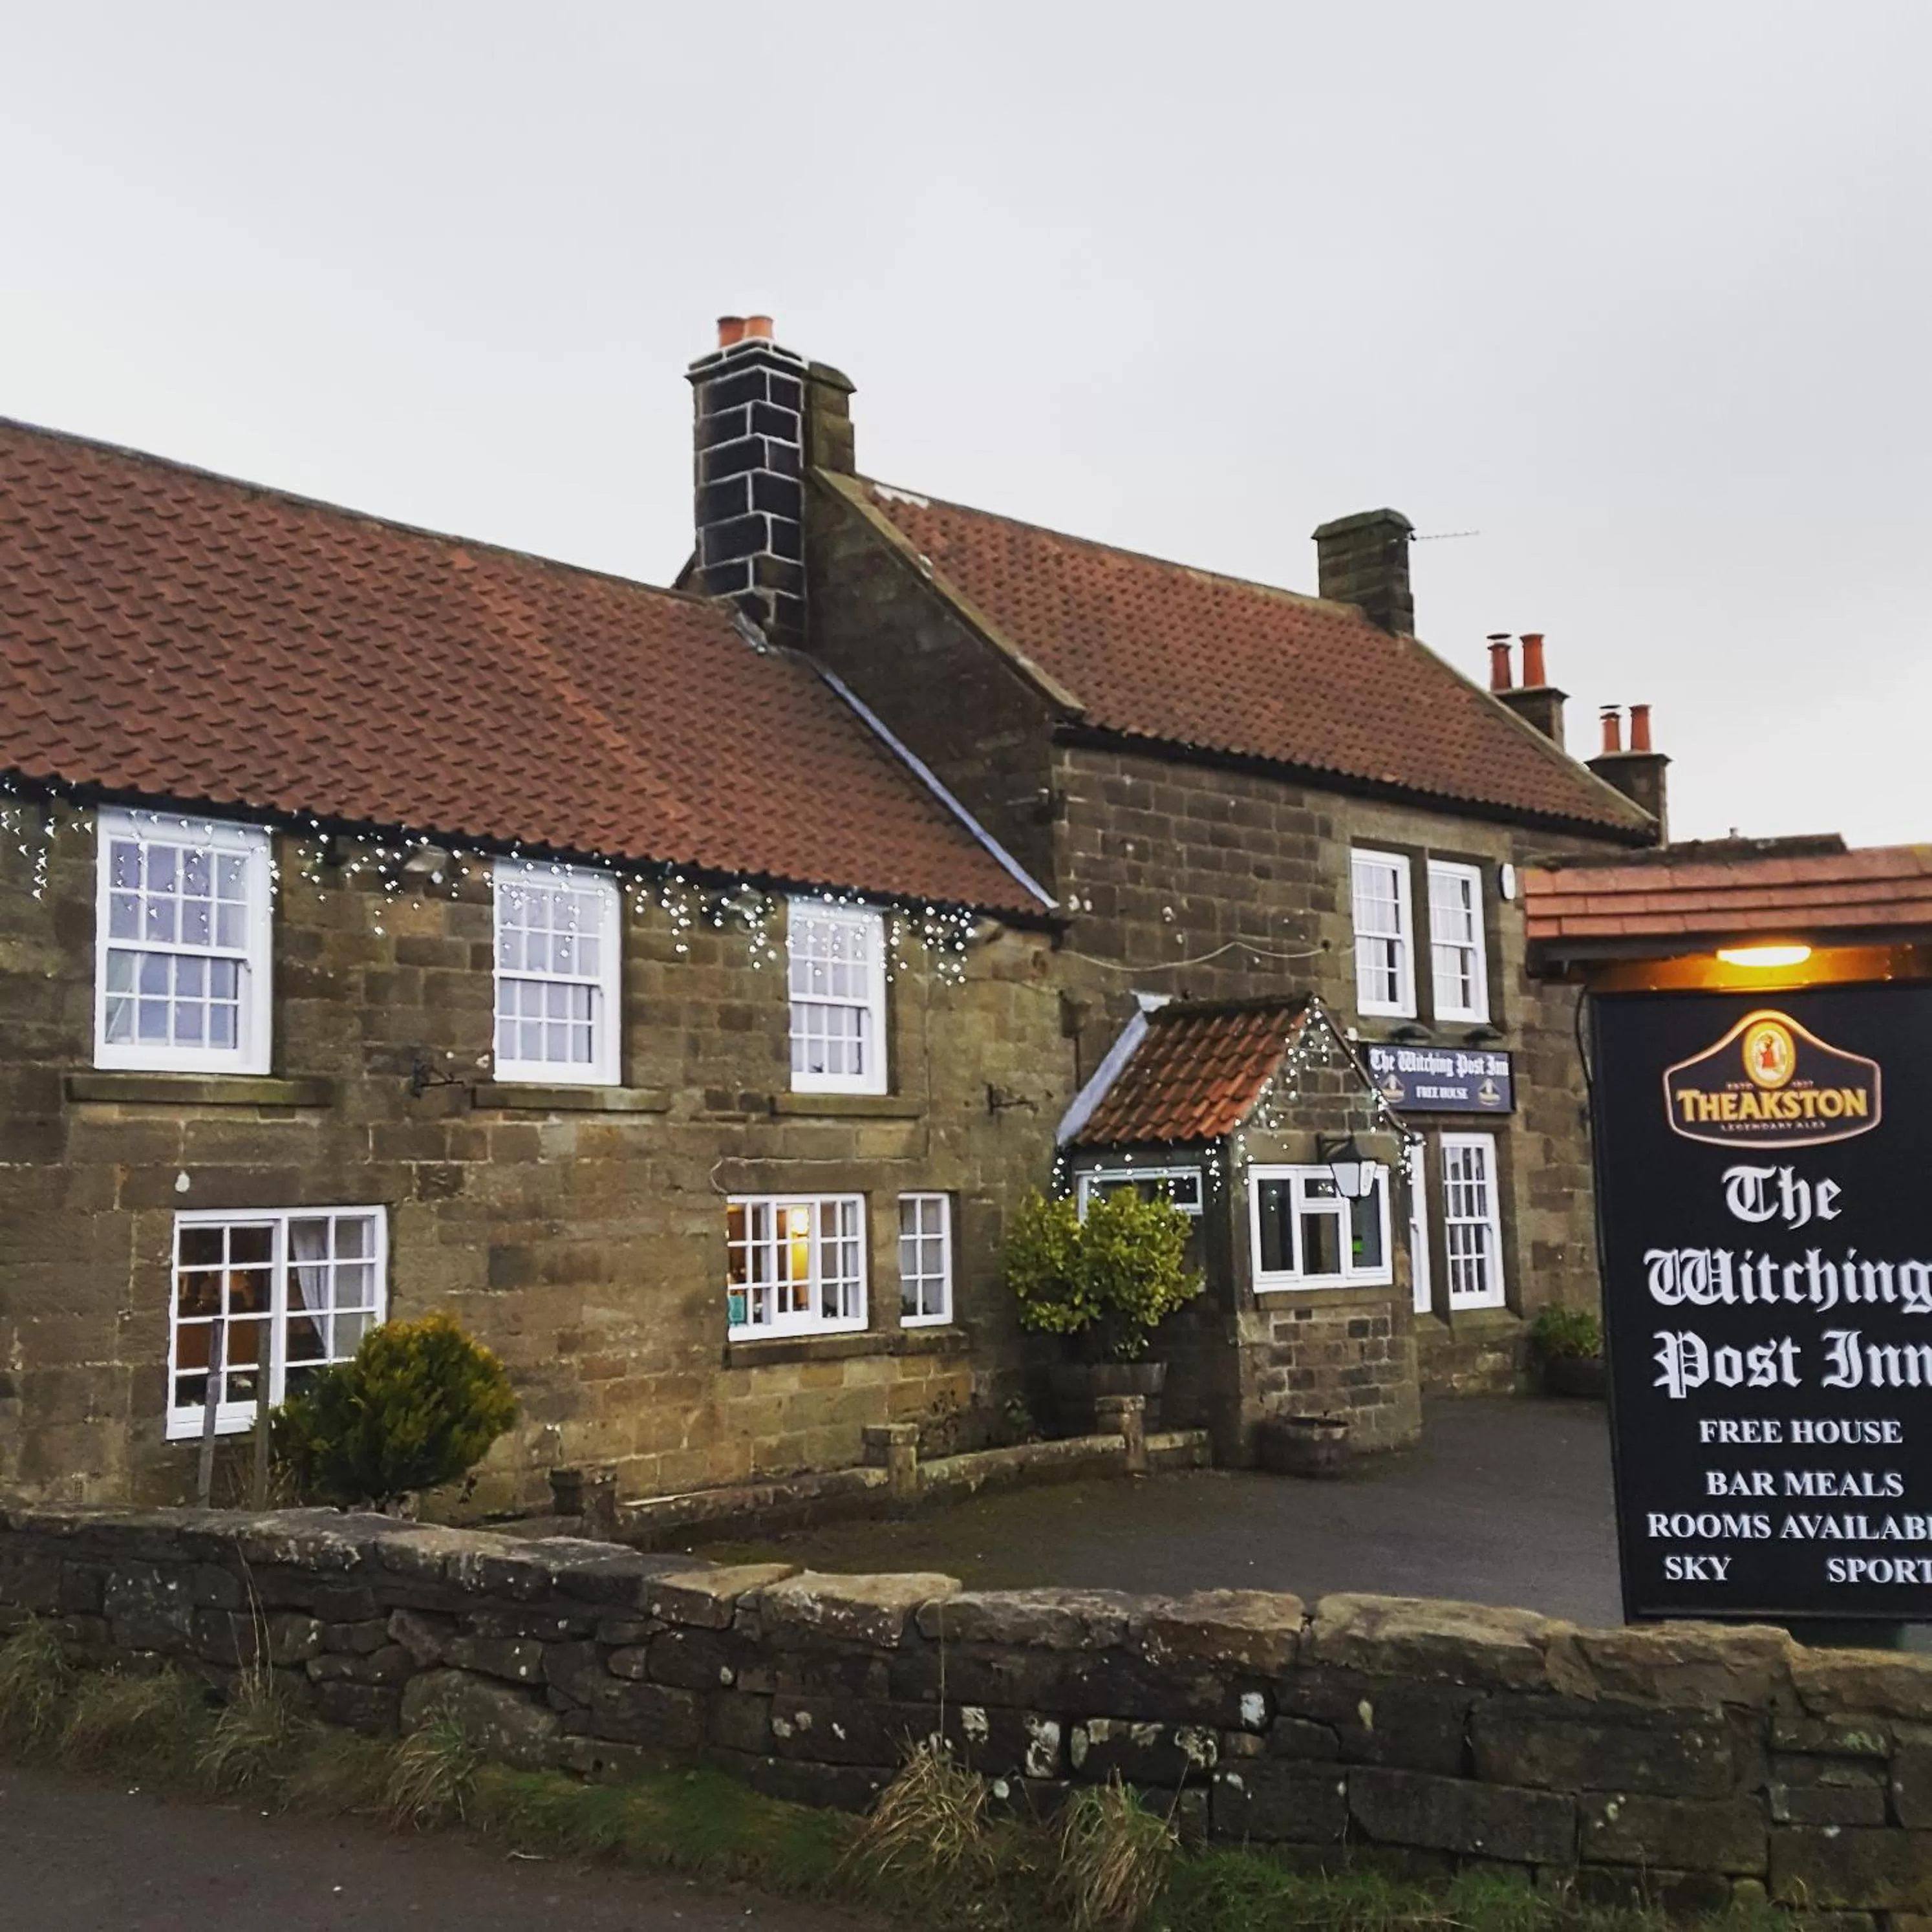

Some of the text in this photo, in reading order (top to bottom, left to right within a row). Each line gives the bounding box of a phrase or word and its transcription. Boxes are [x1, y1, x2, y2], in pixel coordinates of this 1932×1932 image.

[1369, 1047, 1510, 1079] The Witching Post Inn
[1415, 1085, 1470, 1099] FREE HOUSE
[1676, 1088, 1869, 1122] THEAKSTON
[1720, 1119, 1827, 1132] LEGENDARY ALES
[1721, 1165, 1842, 1230] The
[1643, 1248, 1932, 1314] Witching
[1653, 1329, 1932, 1399] Post Inn
[1699, 1420, 1903, 1444] FREE HOUSE
[1705, 1471, 1905, 1497] BAR MEALS
[1646, 1513, 1932, 1540] ROOMS AVAILAB
[1664, 1556, 1732, 1580] SKY
